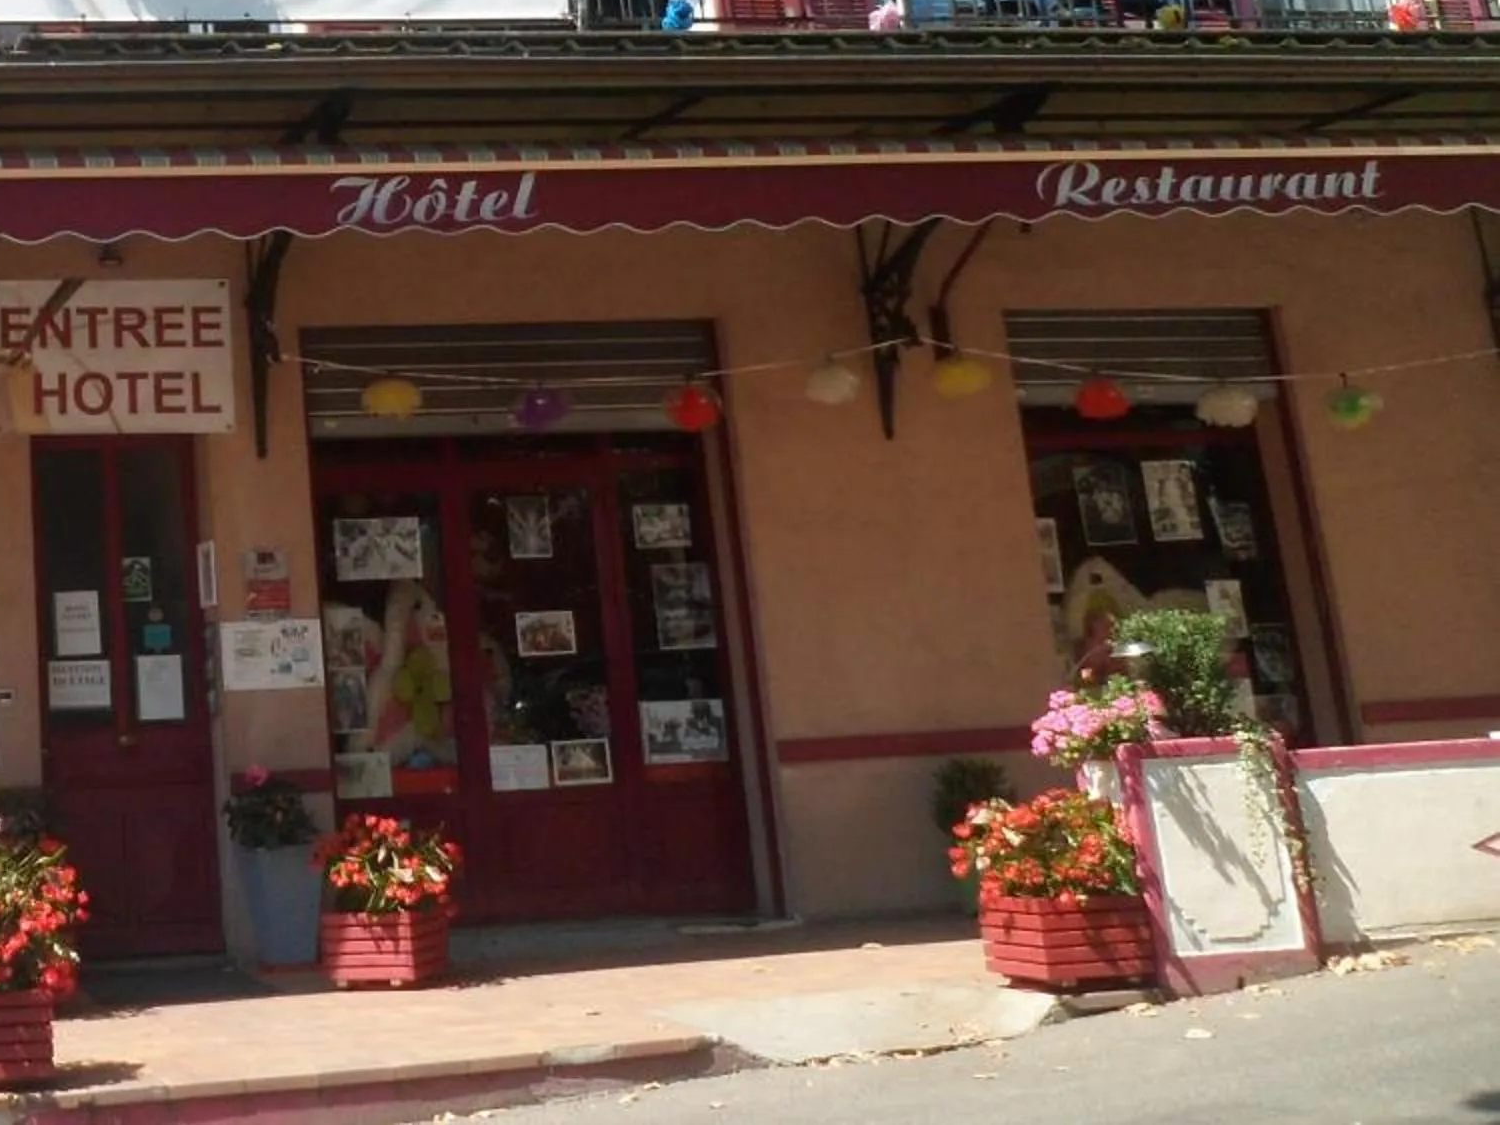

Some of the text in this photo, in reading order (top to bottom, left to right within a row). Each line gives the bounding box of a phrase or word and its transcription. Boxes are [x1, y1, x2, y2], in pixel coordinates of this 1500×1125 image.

[329, 172, 538, 225] Hôtel
[1035, 160, 1386, 207] Restaurant
[1, 306, 225, 350] ENTREE
[32, 371, 223, 416] HOTEL
